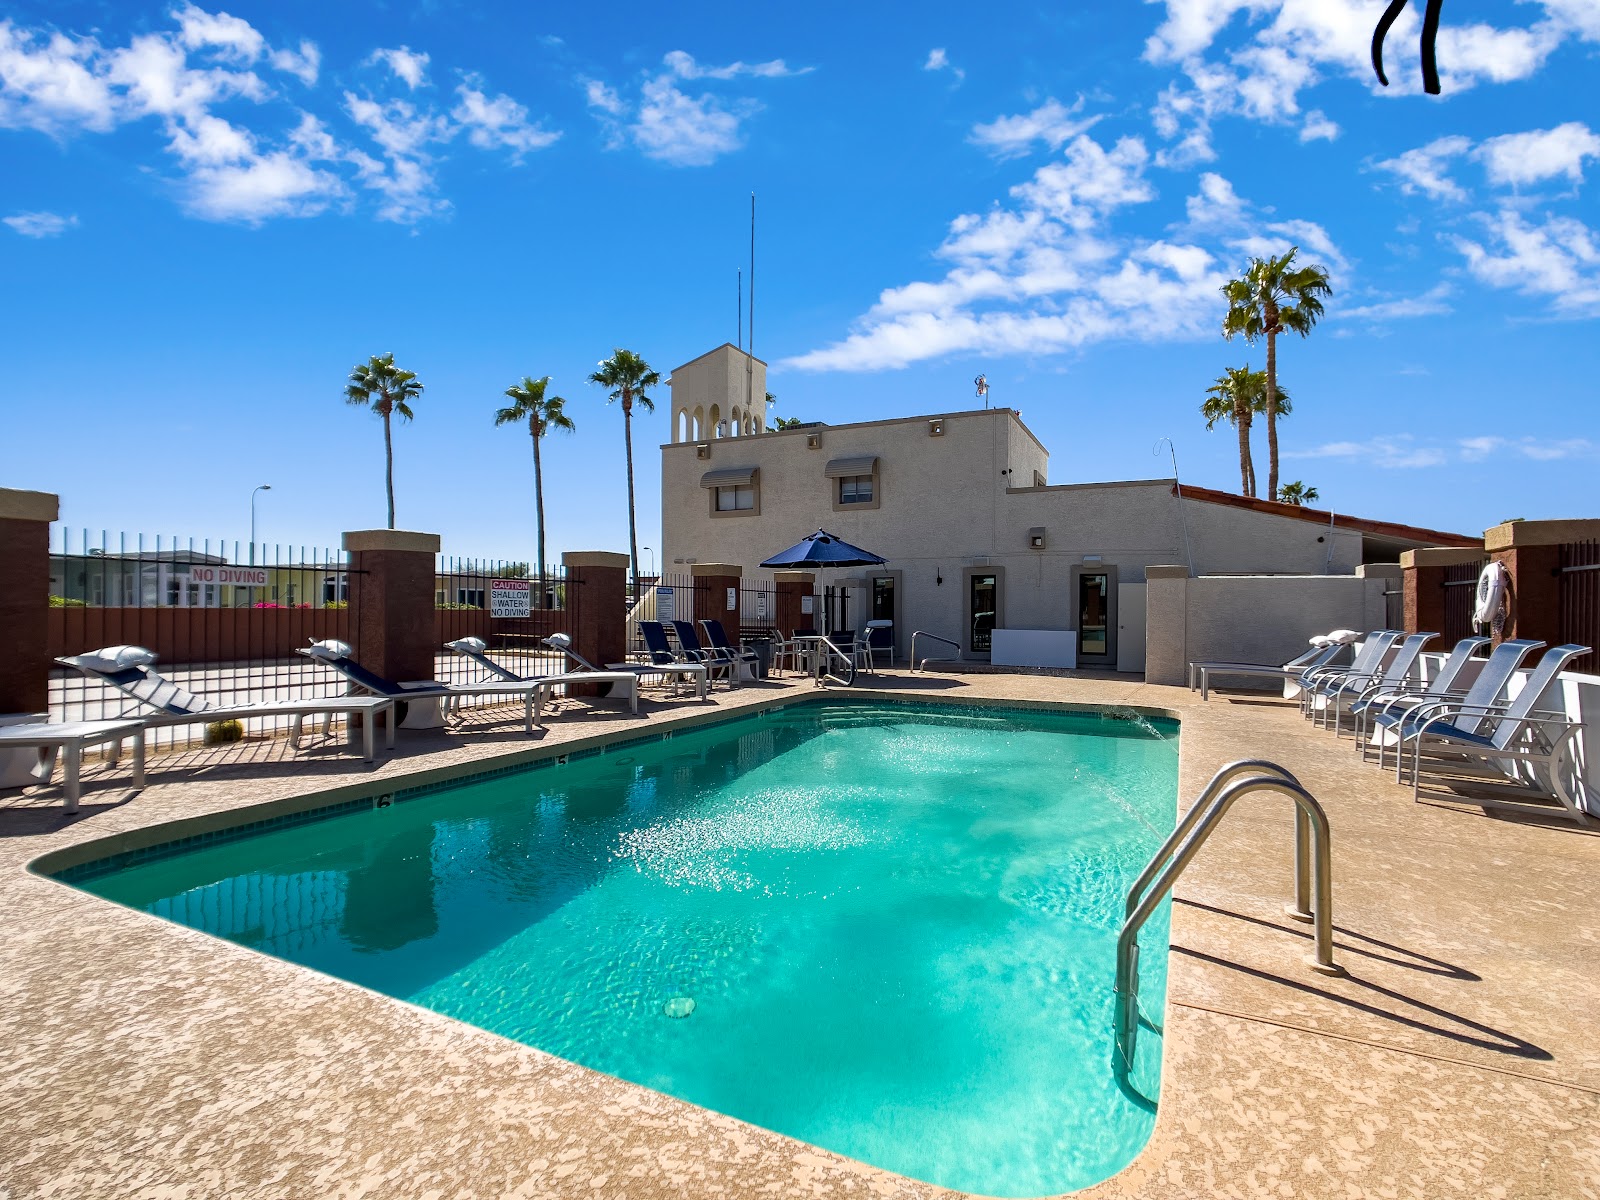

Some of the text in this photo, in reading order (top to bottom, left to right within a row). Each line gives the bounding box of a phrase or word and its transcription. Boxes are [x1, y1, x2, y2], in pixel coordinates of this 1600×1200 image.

[192, 568, 265, 584] NO DIVING
[492, 581, 528, 590] CAUTION
[491, 590, 529, 599] SHALLOW
[497, 599, 524, 608] WATER
[491, 608, 529, 617] NO DIVING
[377, 794, 391, 808] 6
